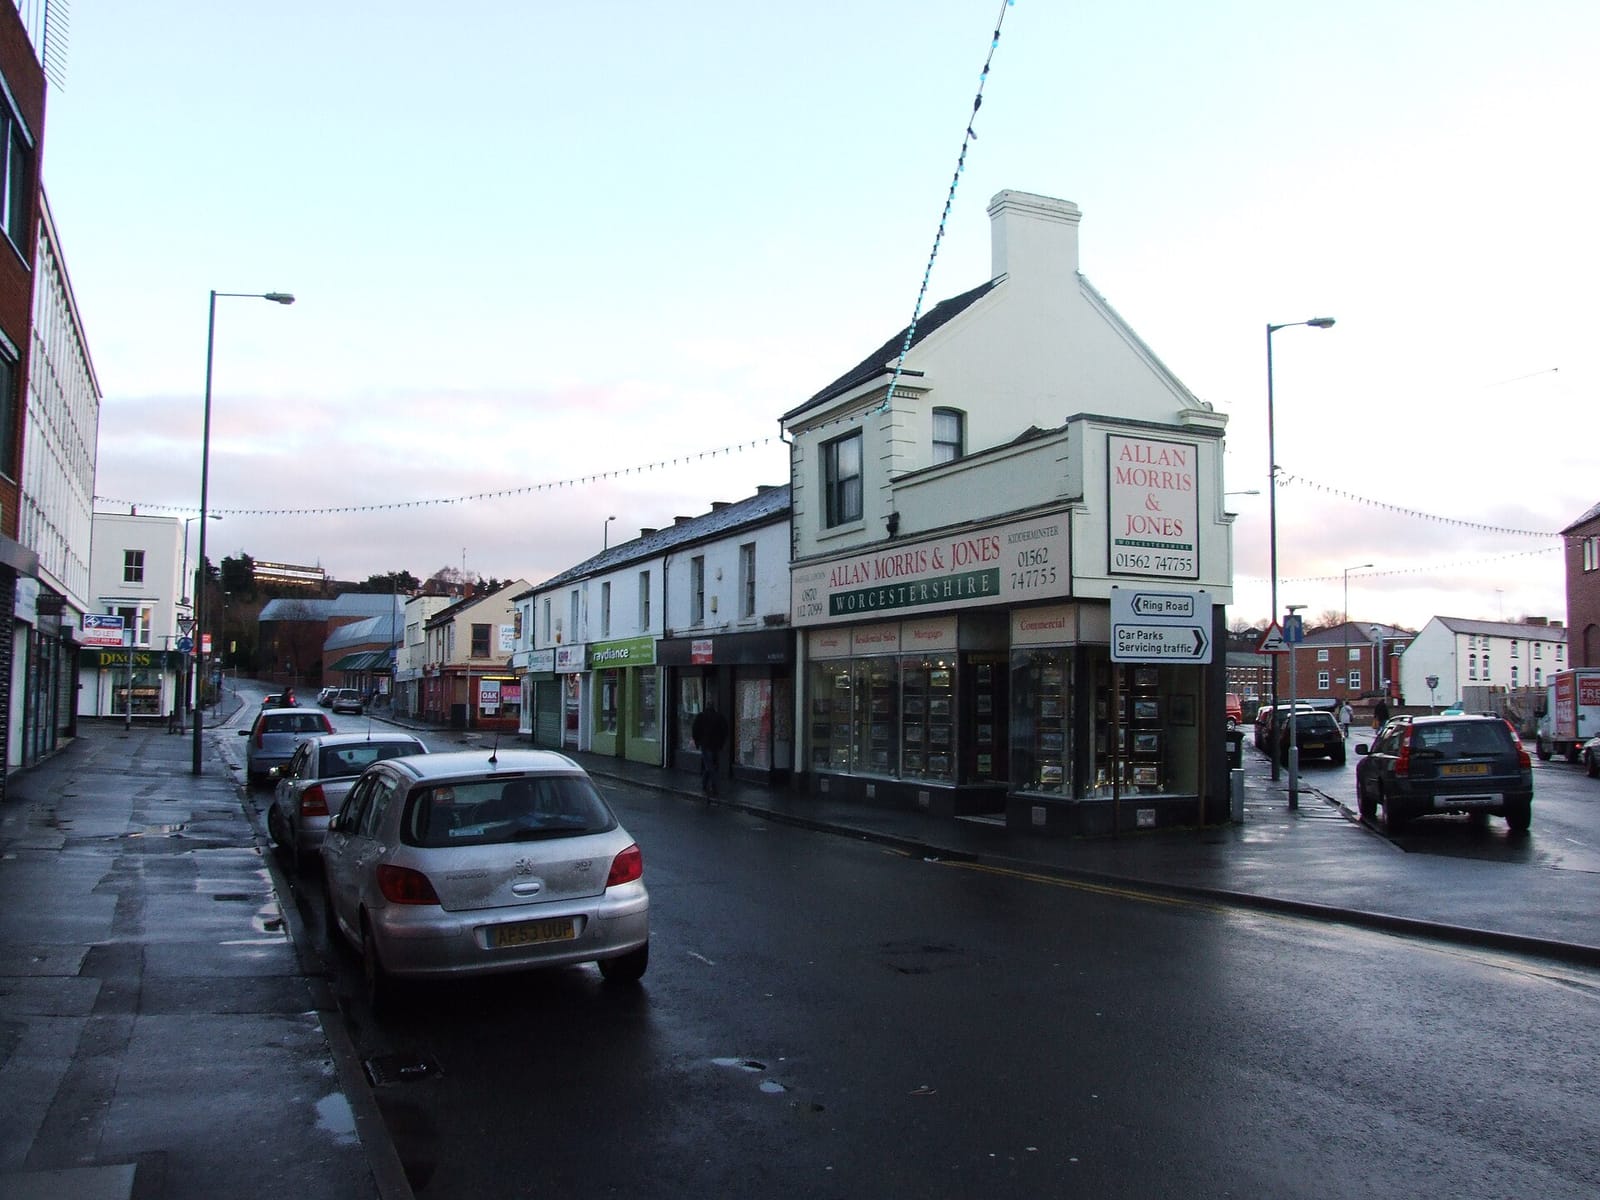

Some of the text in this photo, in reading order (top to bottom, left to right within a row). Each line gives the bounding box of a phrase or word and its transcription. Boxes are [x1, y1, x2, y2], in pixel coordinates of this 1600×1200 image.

[1120, 444, 1187, 468] ALLAN
[1116, 466, 1192, 492] MORRIS
[1145, 492, 1162, 512] &
[1008, 525, 1059, 545] KIDDERMINSTER
[1125, 514, 1184, 537] JONES
[1118, 539, 1191, 551] WORCESTERSHIRE
[829, 560, 870, 588] ALLAN
[874, 550, 927, 580] MORRIS
[932, 546, 945, 570] &
[950, 535, 1000, 572] JONES
[1017, 547, 1049, 568] 01562
[1115, 553, 1193, 572] 01562 747755
[1010, 566, 1057, 590] 747755
[835, 574, 990, 611] WORCESTERSHIRE
[1142, 600, 1190, 612] Ring Road
[1020, 616, 1065, 631] Commercial
[1118, 630, 1164, 641] Car Parks
[593, 648, 630, 663] raydiance
[1118, 642, 1193, 655] Servicing traffic
[482, 691, 498, 700] OAK
